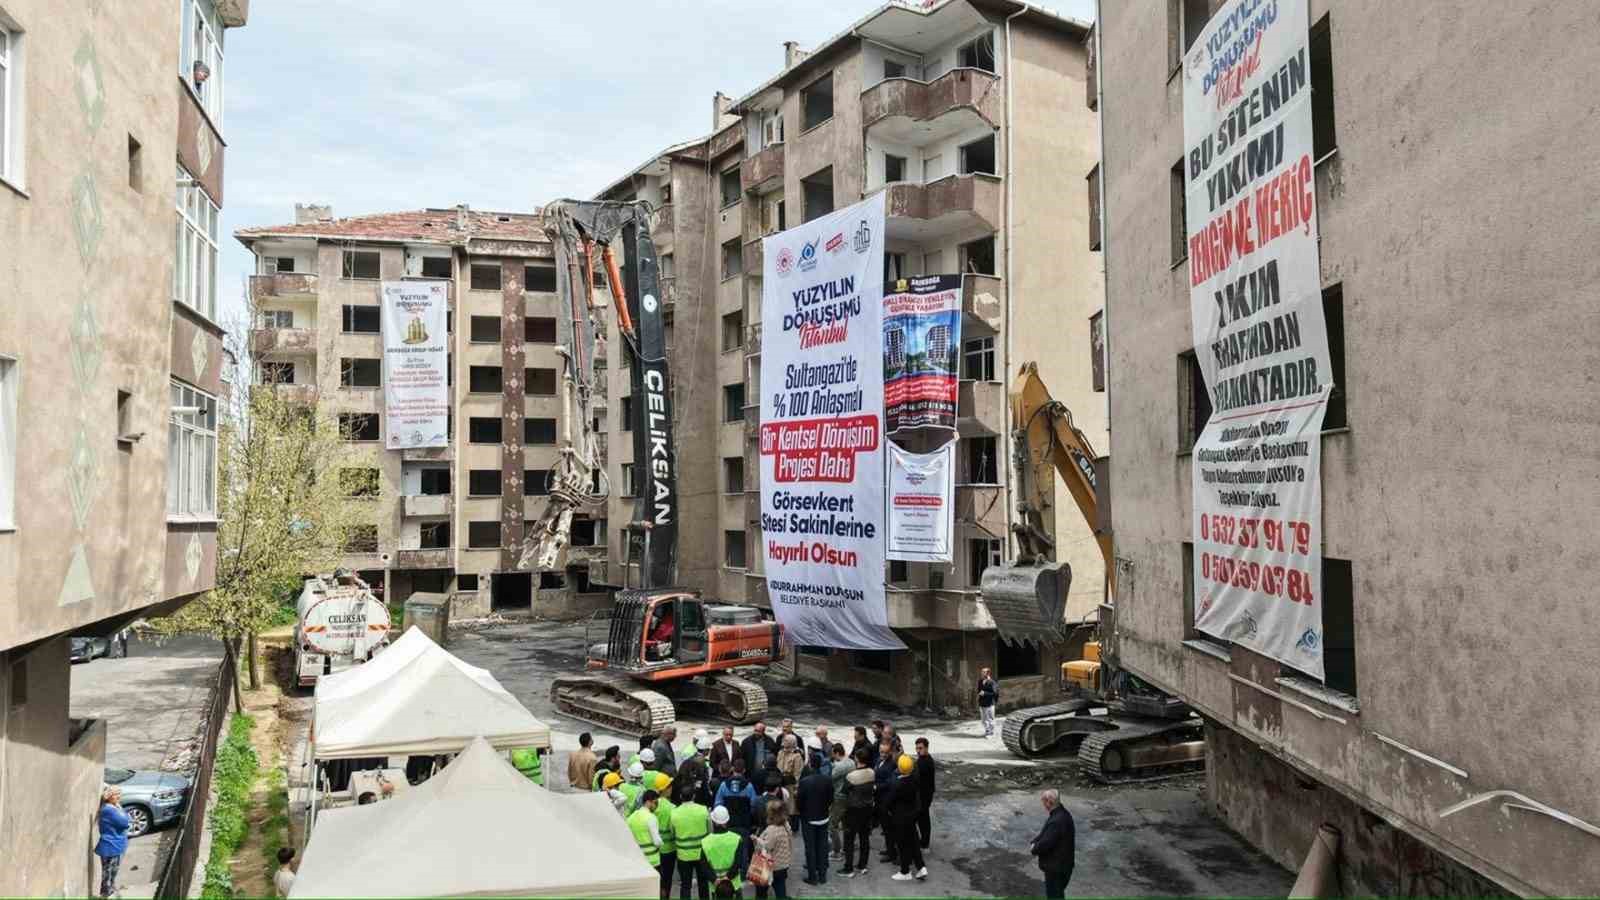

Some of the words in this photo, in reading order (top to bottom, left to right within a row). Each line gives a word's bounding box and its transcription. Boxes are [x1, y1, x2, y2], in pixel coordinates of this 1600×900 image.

[1190, 133, 1214, 181] BU
[1217, 47, 1306, 155] SİTENİN
[1206, 123, 1284, 212] YIKIMI
[792, 275, 855, 309] YÜZYILIN
[783, 295, 861, 332] DÖNÜŞÜMÜ
[786, 355, 857, 390] Sultangazi'de
[773, 393, 786, 417] %
[789, 391, 809, 417] 100
[643, 369, 673, 526] ÇELİKSAN
[762, 427, 777, 451] Bir
[778, 425, 818, 450] Kentsel
[821, 420, 874, 453] Dönüşüm
[779, 452, 817, 481] Projesi
[773, 491, 854, 513] Görsevkent
[789, 514, 876, 538] Sakinlerine
[1201, 513, 1209, 541] 0
[1212, 514, 1236, 546] 532
[1288, 521, 1311, 556] 79
[768, 540, 809, 566] Hayırlı
[811, 542, 858, 567] Olsun
[1202, 552, 1210, 579] 0
